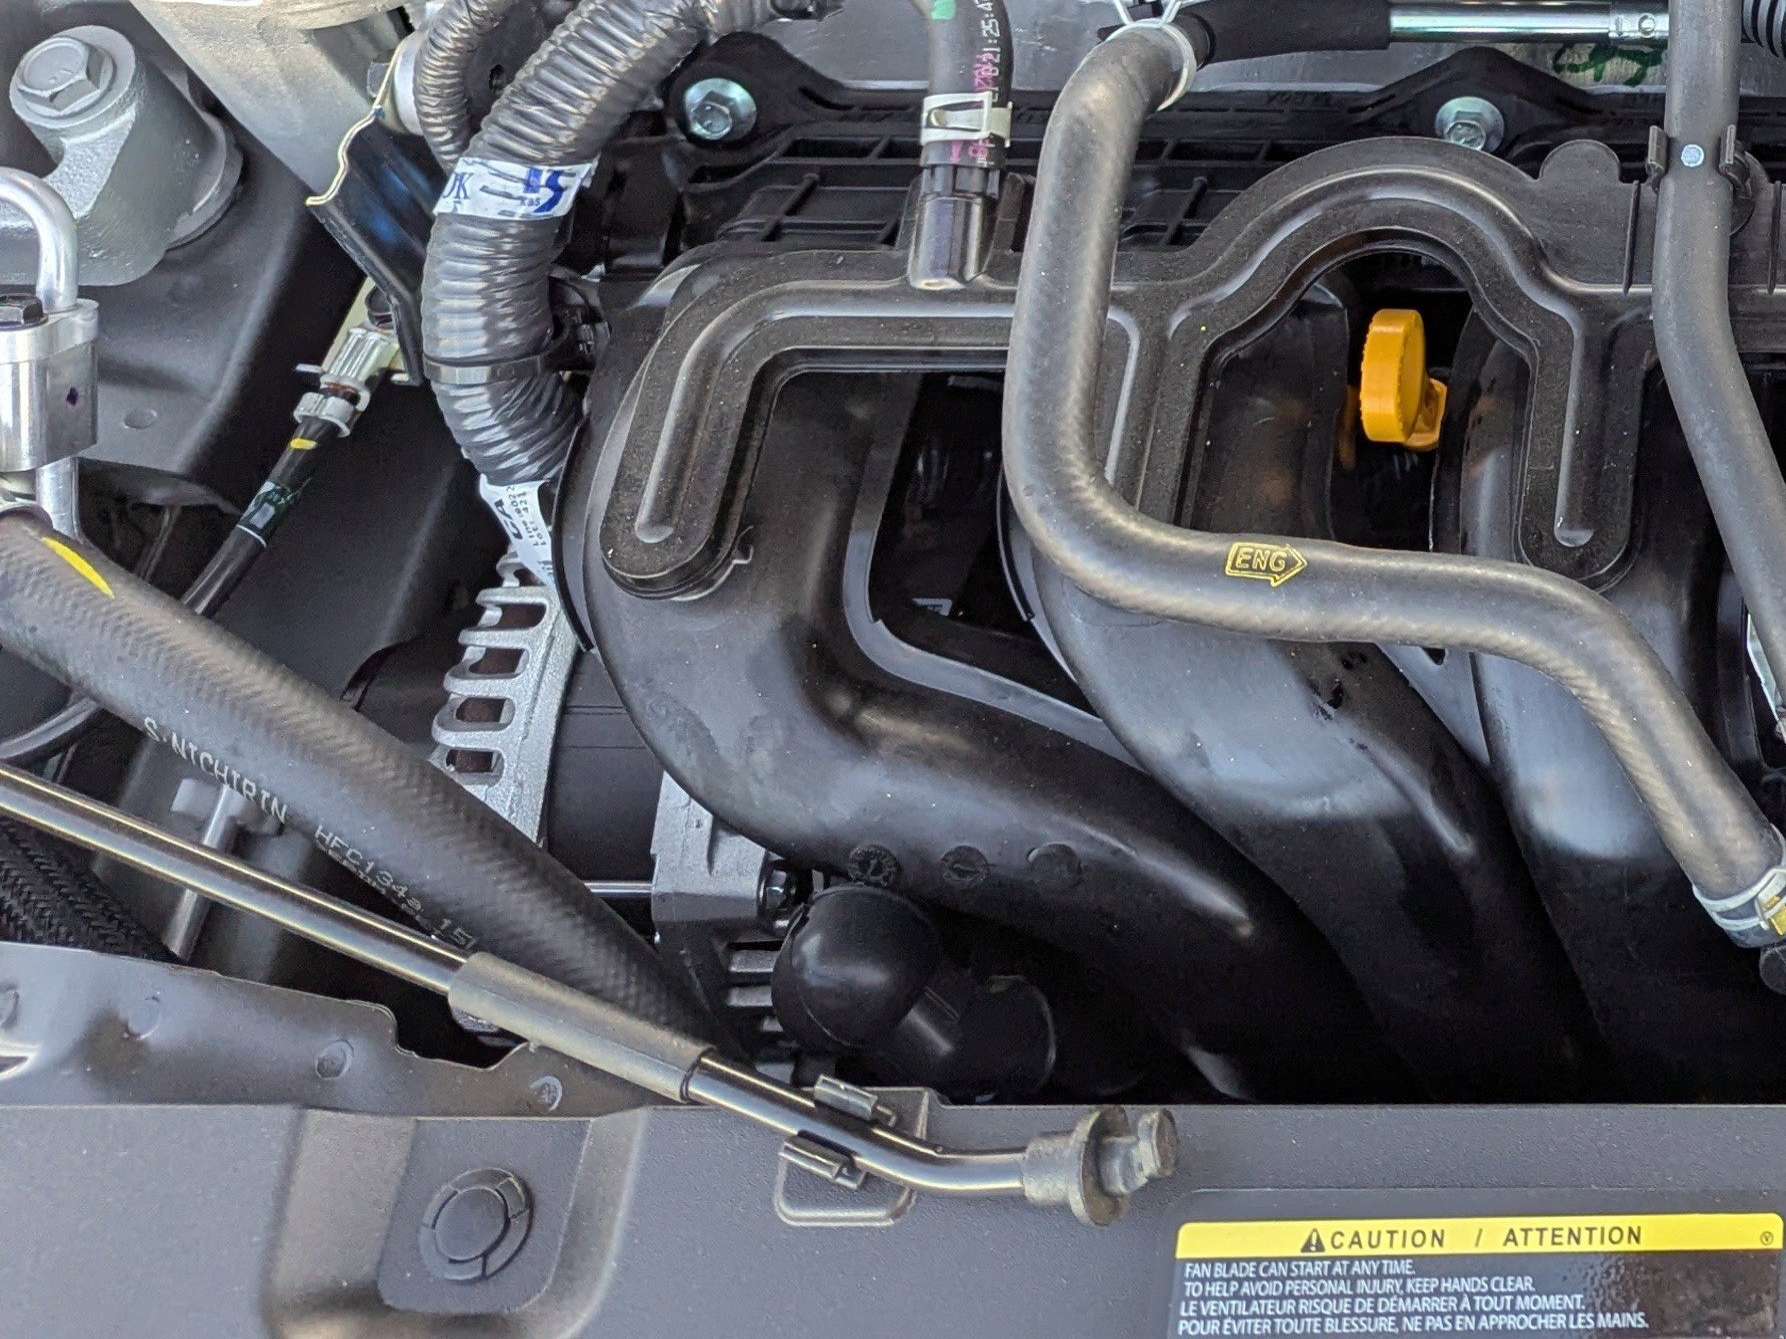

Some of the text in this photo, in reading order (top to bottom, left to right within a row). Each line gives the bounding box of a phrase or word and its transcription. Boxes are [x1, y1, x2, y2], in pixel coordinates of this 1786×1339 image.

[1235, 547, 1288, 572] ENG
[1330, 1229, 1446, 1250] CAUTION
[1502, 1225, 1643, 1247] ATTENTION
[1184, 1259, 1416, 1279] FAN BLADE CAN START AT ANY TIME.
[1184, 1276, 1536, 1298] TO HELP AVOID PERSONAL INJURY, KEEP HANDS CLEAR.
[1179, 1293, 1585, 1317] LE VENTILATEUR RISQUE DE DÉMARRER À TOUT MOMENT.
[1178, 1312, 1649, 1336] POUR ÉVITER TOUTE BLESSURE, NE PAS EN APPROCHER LES MAINS.
